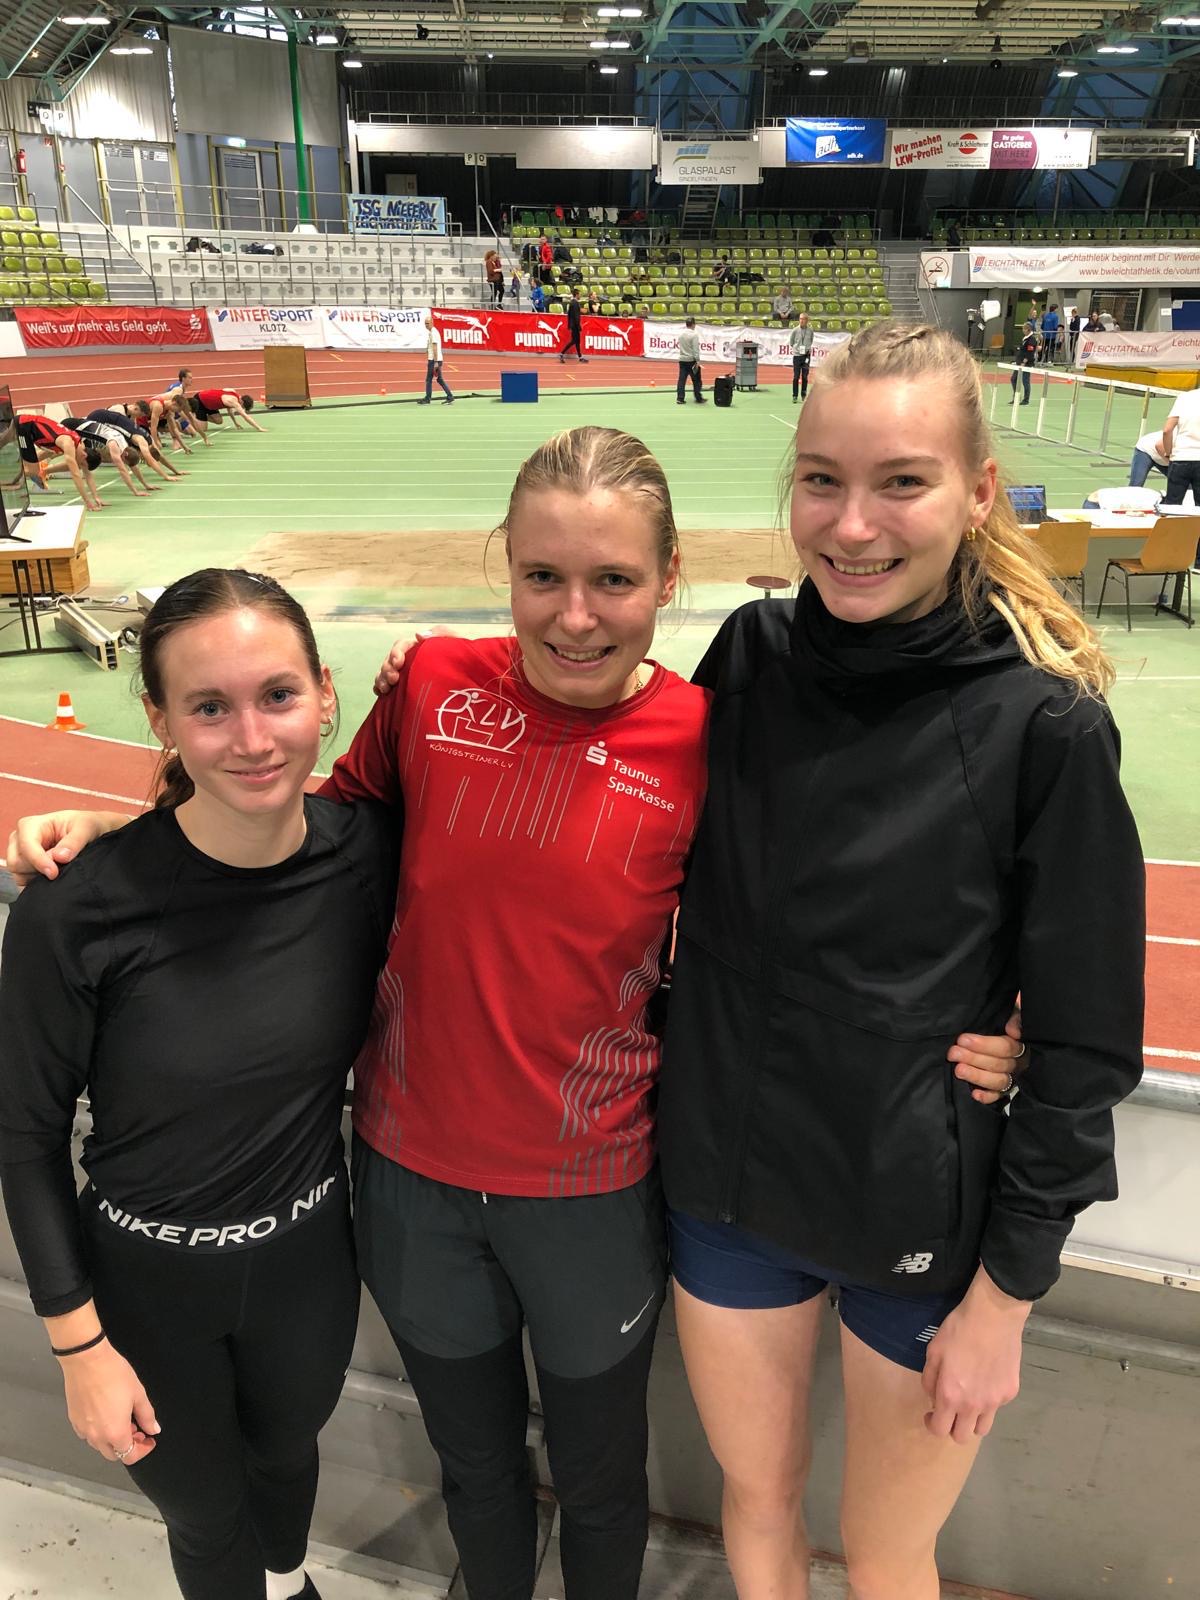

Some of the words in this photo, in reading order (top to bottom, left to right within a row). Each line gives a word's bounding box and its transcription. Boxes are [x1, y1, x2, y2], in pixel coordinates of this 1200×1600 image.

[894, 143, 908, 154] Wir
[910, 134, 942, 150] machen
[894, 144, 944, 167] LKW-Profis!
[678, 166, 736, 176] GLASPALAST
[352, 198, 382, 216] TSG
[1057, 252, 1110, 262] Leichtathletik
[1112, 254, 1142, 263] beginnt
[1144, 253, 1156, 262] mit
[229, 309, 312, 322] INTERSPORT
[340, 310, 422, 322] INTERSPORT
[78, 320, 102, 332] mehr
[105, 320, 120, 332] als
[122, 320, 144, 332] Geld
[146, 320, 172, 334] geht.
[260, 324, 288, 332] KLOTZ
[368, 324, 396, 333] KLOTZ
[443, 328, 482, 344] PUMA
[514, 332, 553, 348] PUMA
[585, 336, 624, 350] PUMA
[650, 338, 680, 350] Black
[1092, 344, 1159, 352] LEICHTATHLETIK
[613, 758, 661, 788] Taunus
[607, 776, 675, 813] Sparkasse
[98, 1198, 187, 1244] NIKE
[188, 1216, 277, 1247] PRO
